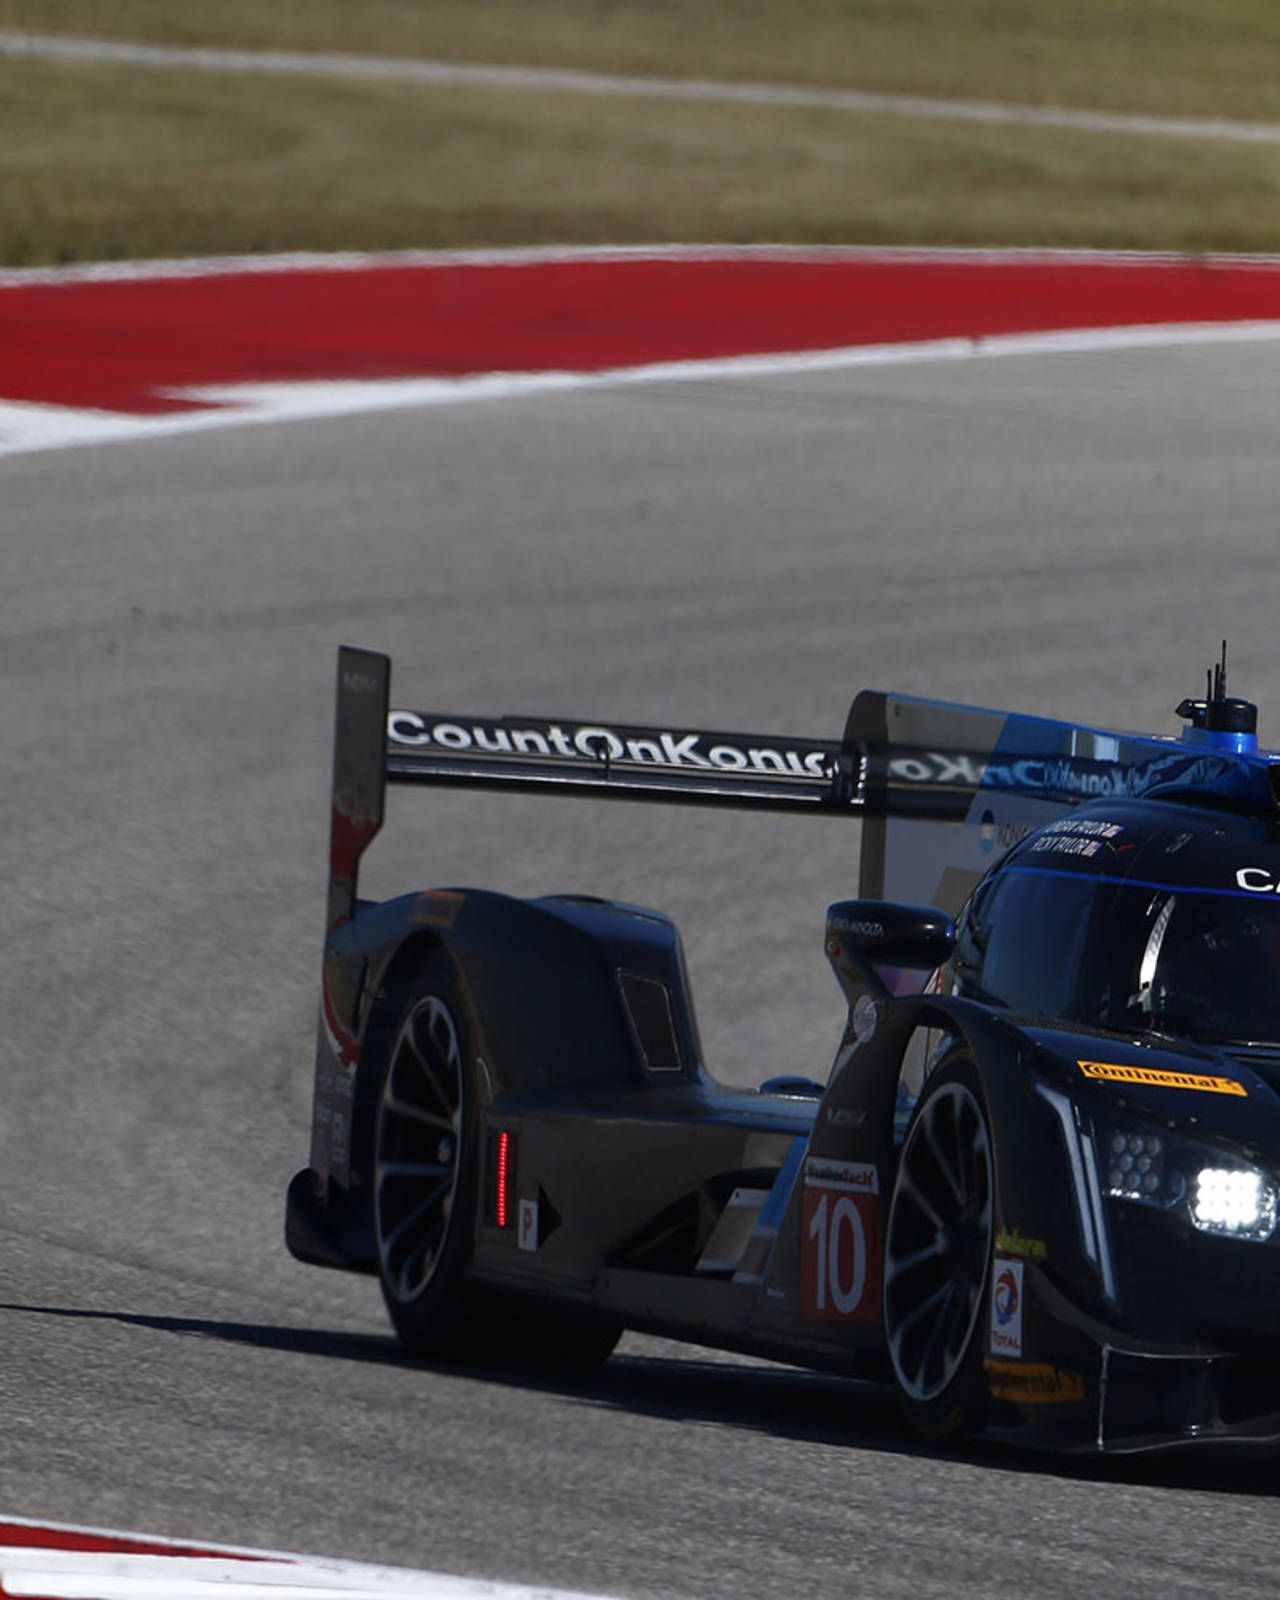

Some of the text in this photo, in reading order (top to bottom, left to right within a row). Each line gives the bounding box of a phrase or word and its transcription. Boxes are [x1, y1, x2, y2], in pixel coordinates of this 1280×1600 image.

[388, 711, 840, 778] CountOnKonic
[1083, 1063, 1219, 1089] Continental
[809, 1193, 867, 1315] 10
[992, 1331, 1021, 1348] TOTAL
